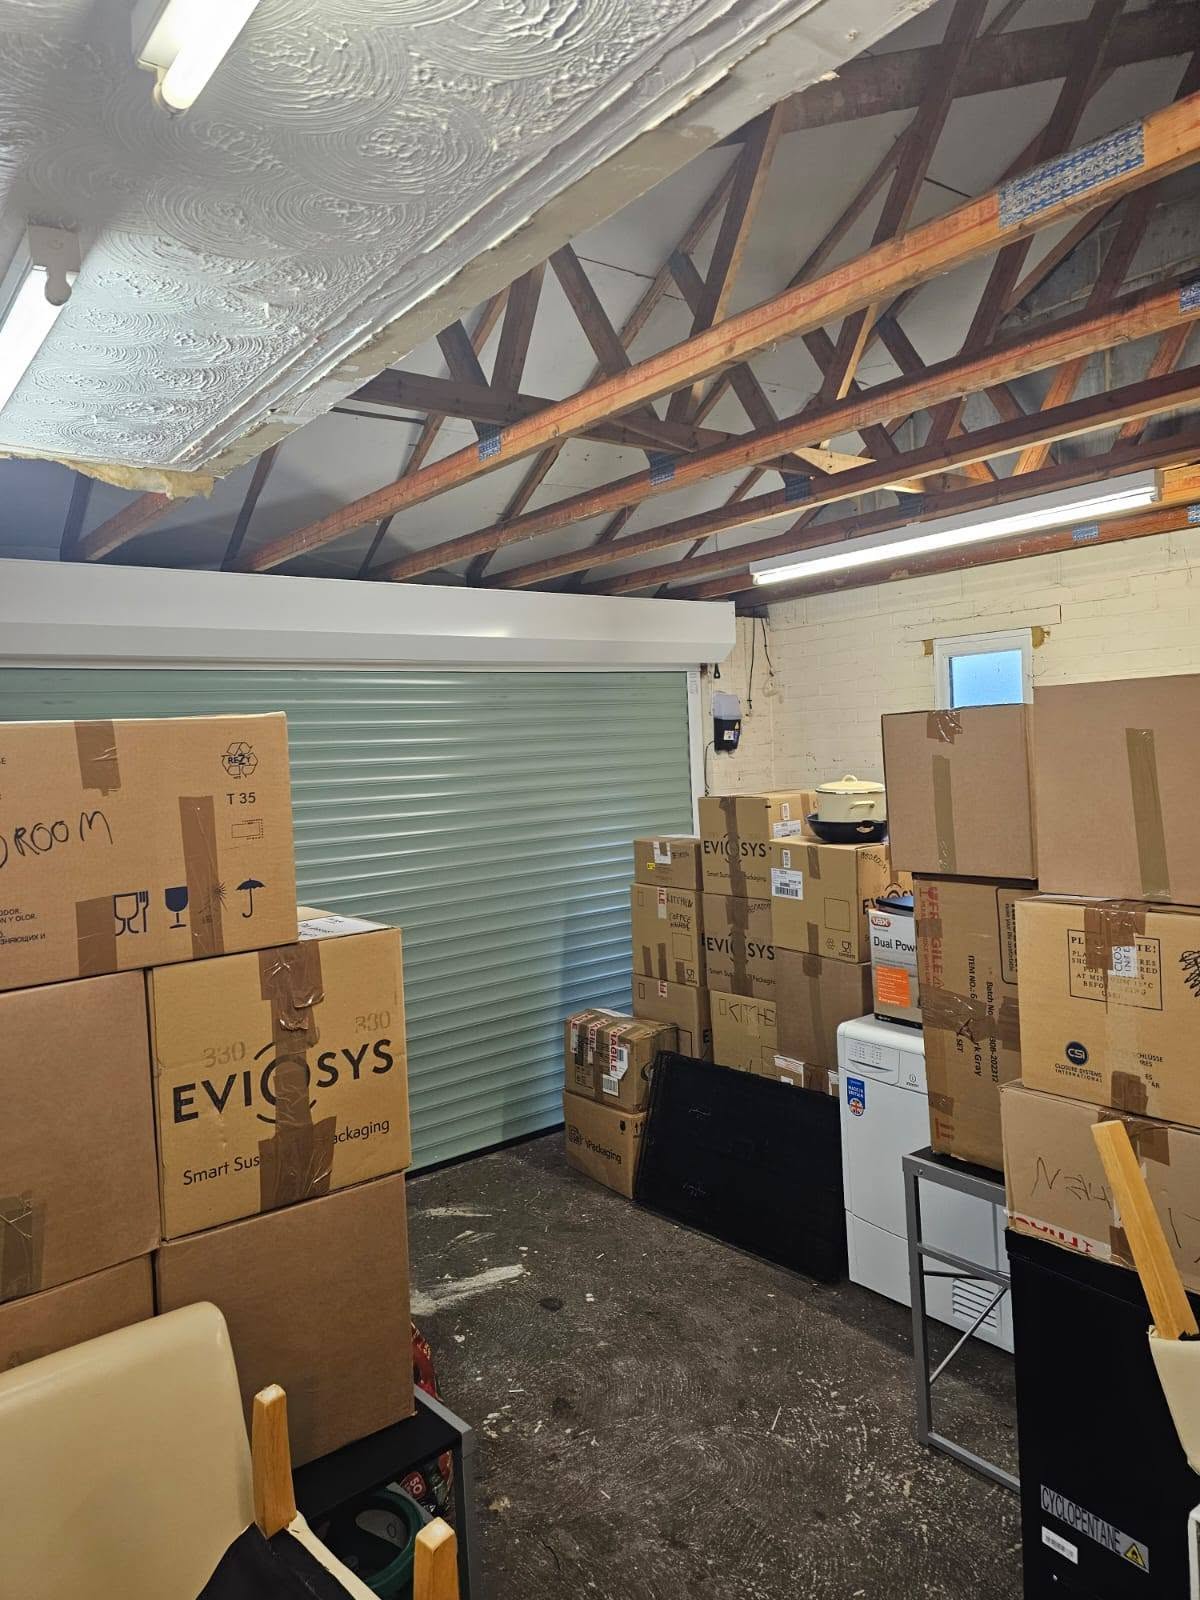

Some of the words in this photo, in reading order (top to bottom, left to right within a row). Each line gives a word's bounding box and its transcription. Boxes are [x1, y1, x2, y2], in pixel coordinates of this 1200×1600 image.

[226, 793, 235, 805] T
[239, 791, 257, 804] 35
[873, 936, 893, 950] Dual
[895, 940, 917, 952] Pow
[928, 902, 944, 975] FRGILE
[986, 981, 995, 1001] Batch
[728, 1003, 777, 1027] KITCHE
[973, 1054, 983, 1077] Gray
[332, 1119, 390, 1144] ackaging
[183, 1163, 230, 1186] Smart
[1042, 1487, 1121, 1556] CYCLOPENTANE
